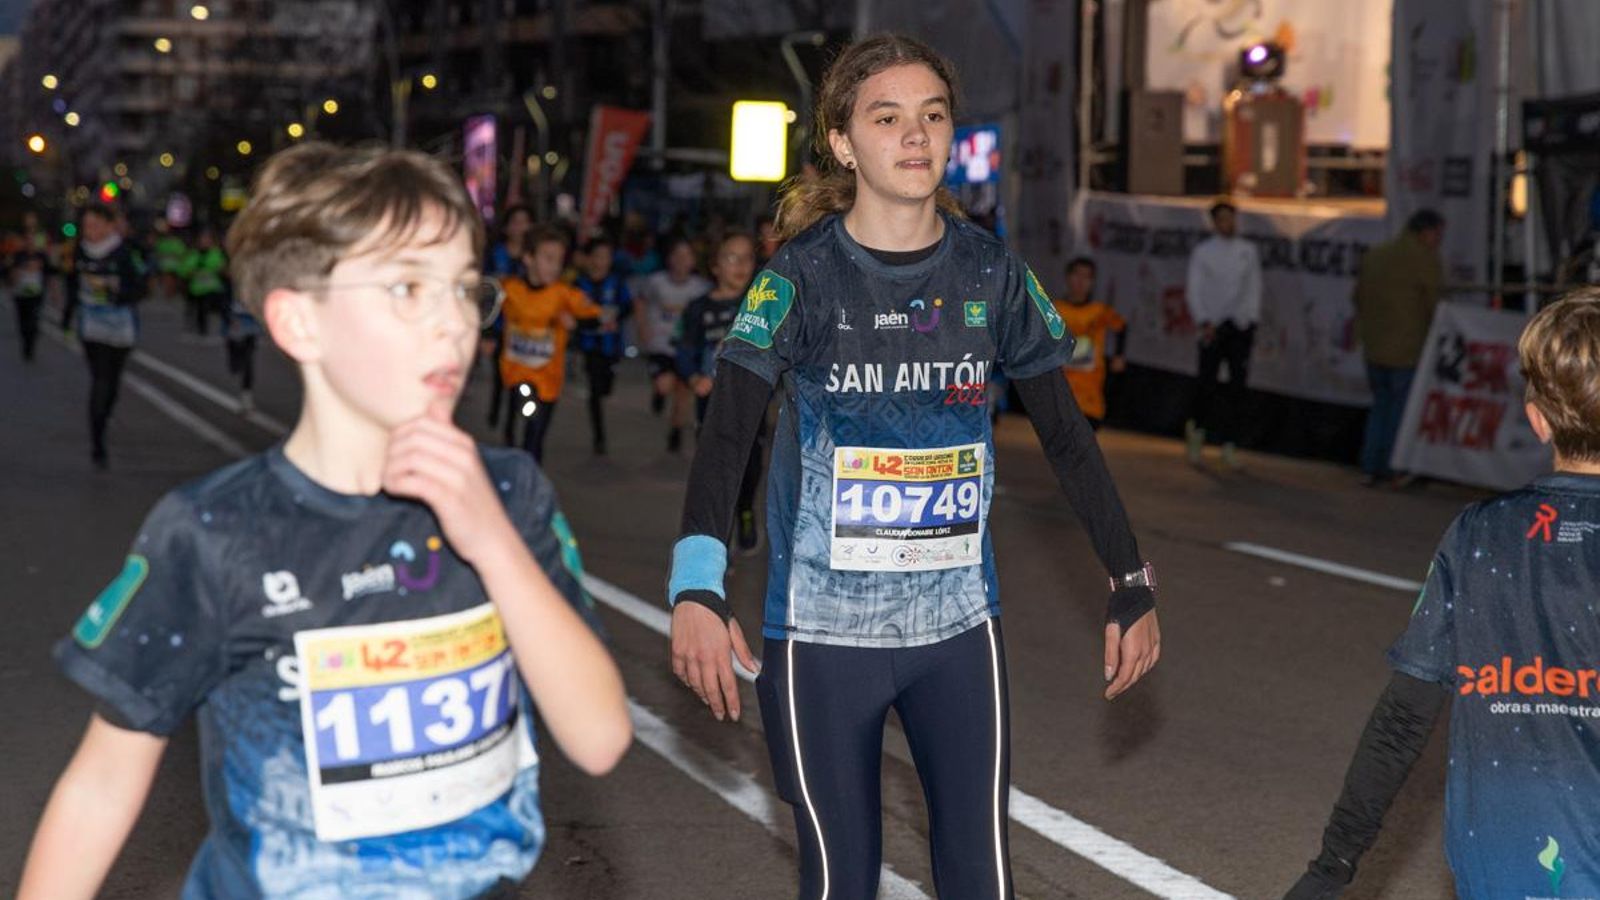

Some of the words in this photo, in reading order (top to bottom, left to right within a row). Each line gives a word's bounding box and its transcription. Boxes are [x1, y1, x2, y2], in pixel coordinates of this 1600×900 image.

[825, 363, 884, 393] SAN
[944, 383, 988, 406] 202
[873, 455, 903, 476] 42
[841, 481, 979, 523] 10749
[360, 640, 409, 672] 42
[1457, 656, 1600, 697] calder
[1490, 702, 1530, 714] obras
